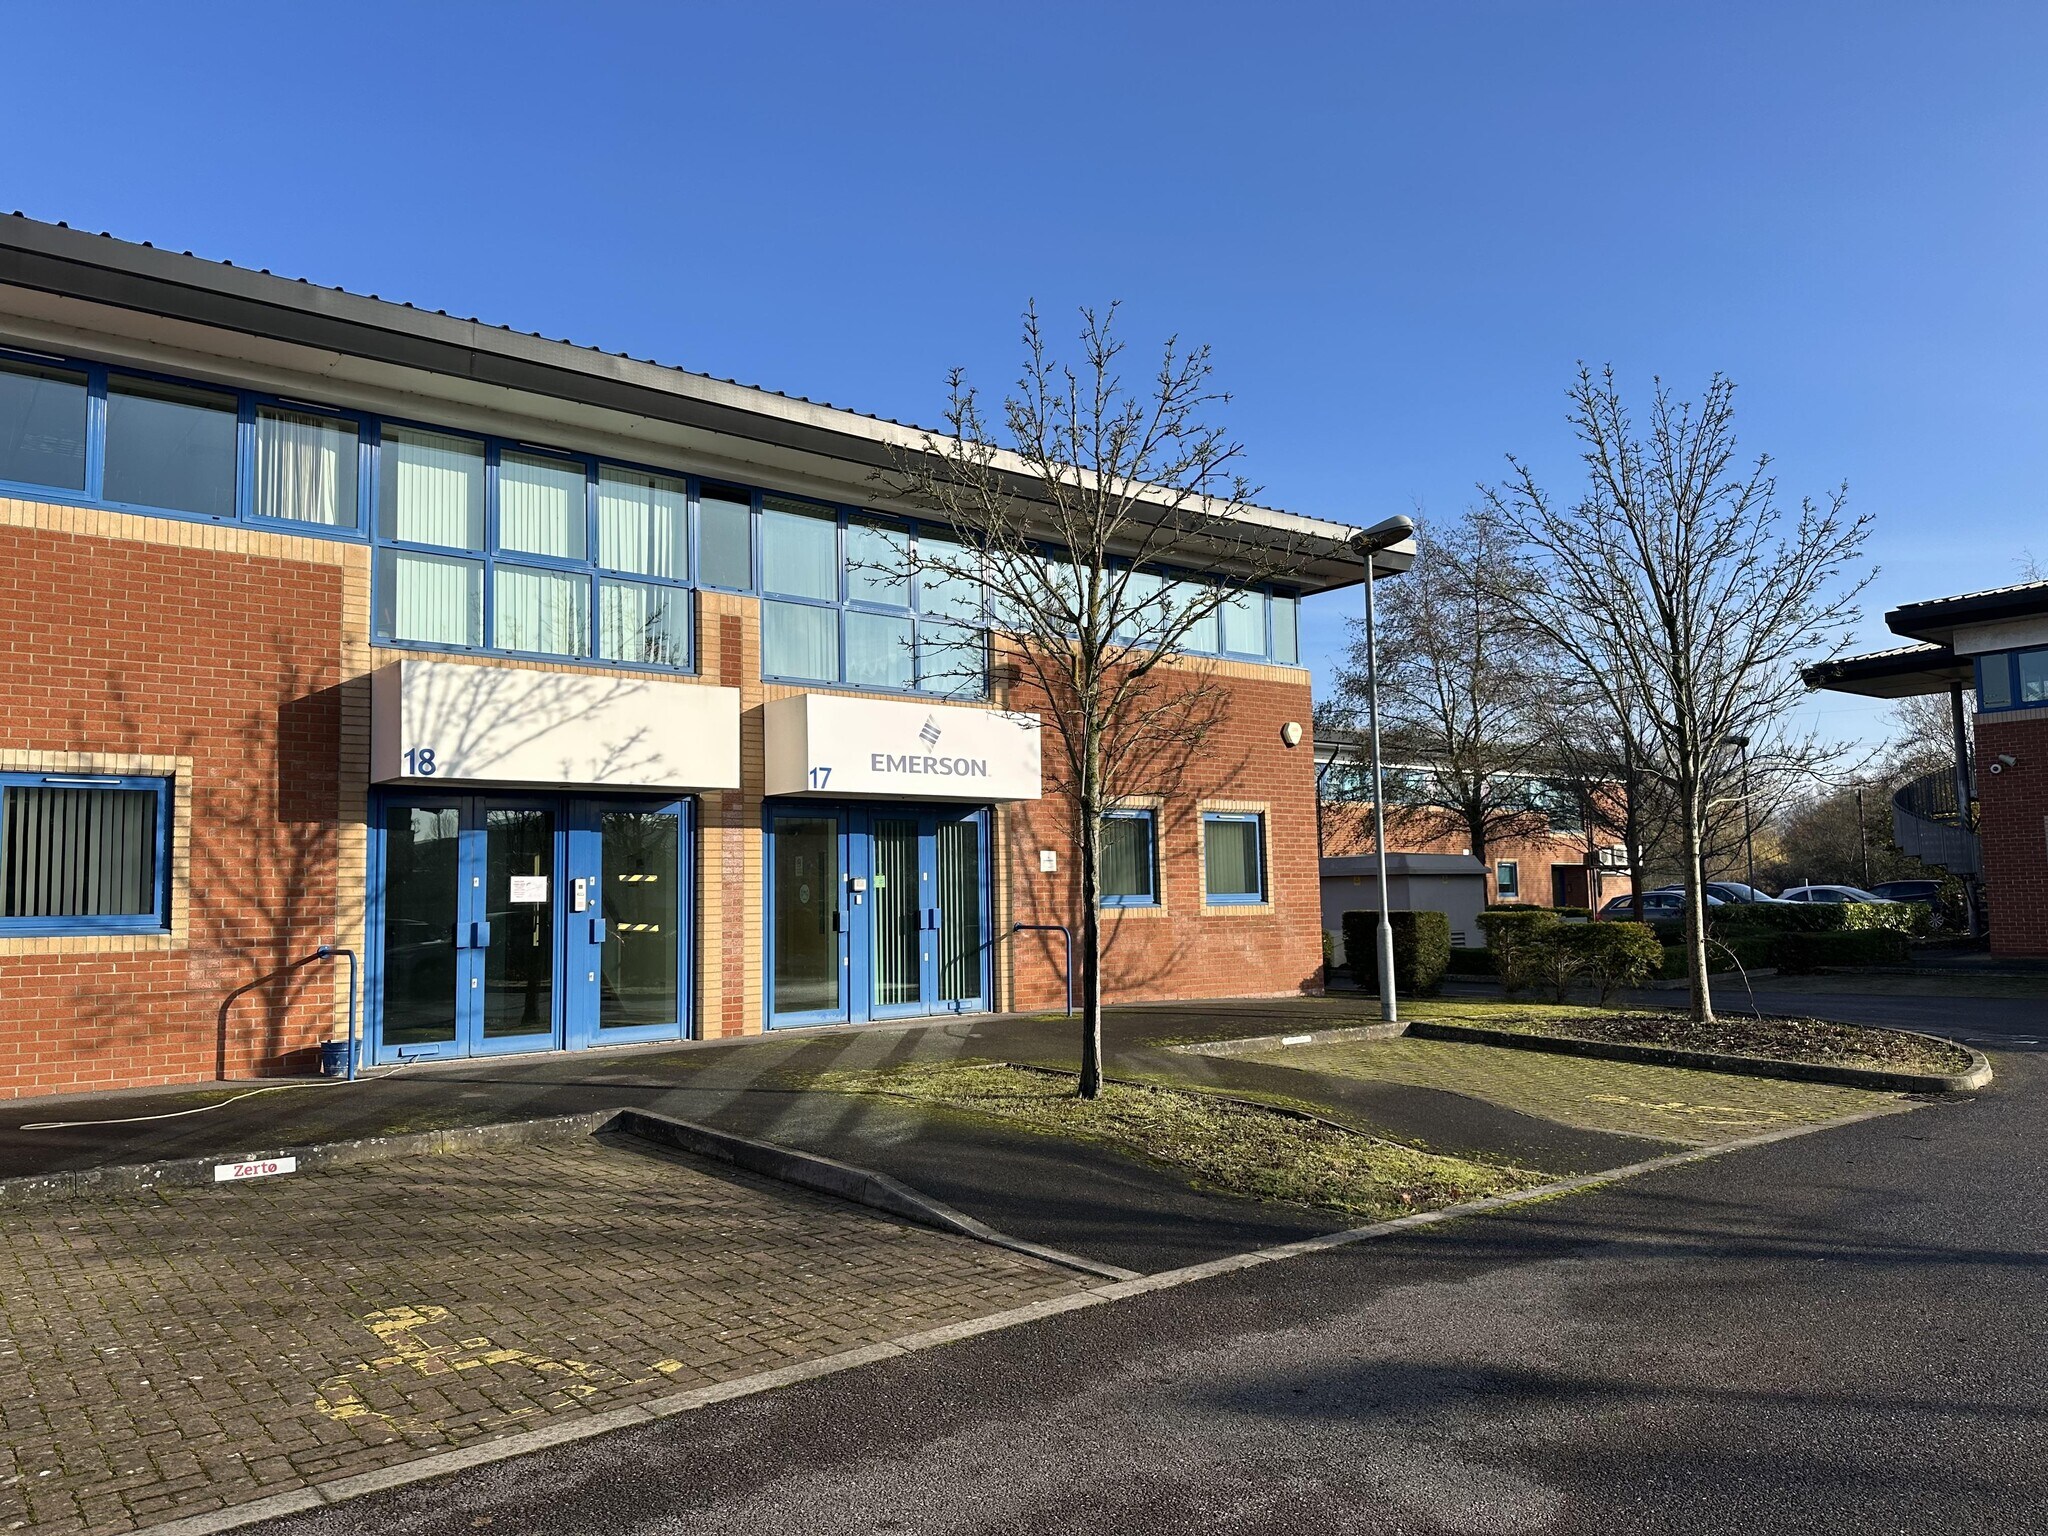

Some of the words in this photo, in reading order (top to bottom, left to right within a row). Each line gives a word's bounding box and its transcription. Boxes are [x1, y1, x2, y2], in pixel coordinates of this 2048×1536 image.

[404, 747, 437, 776] 18
[871, 753, 987, 777] EMERSON
[809, 766, 833, 790] 17
